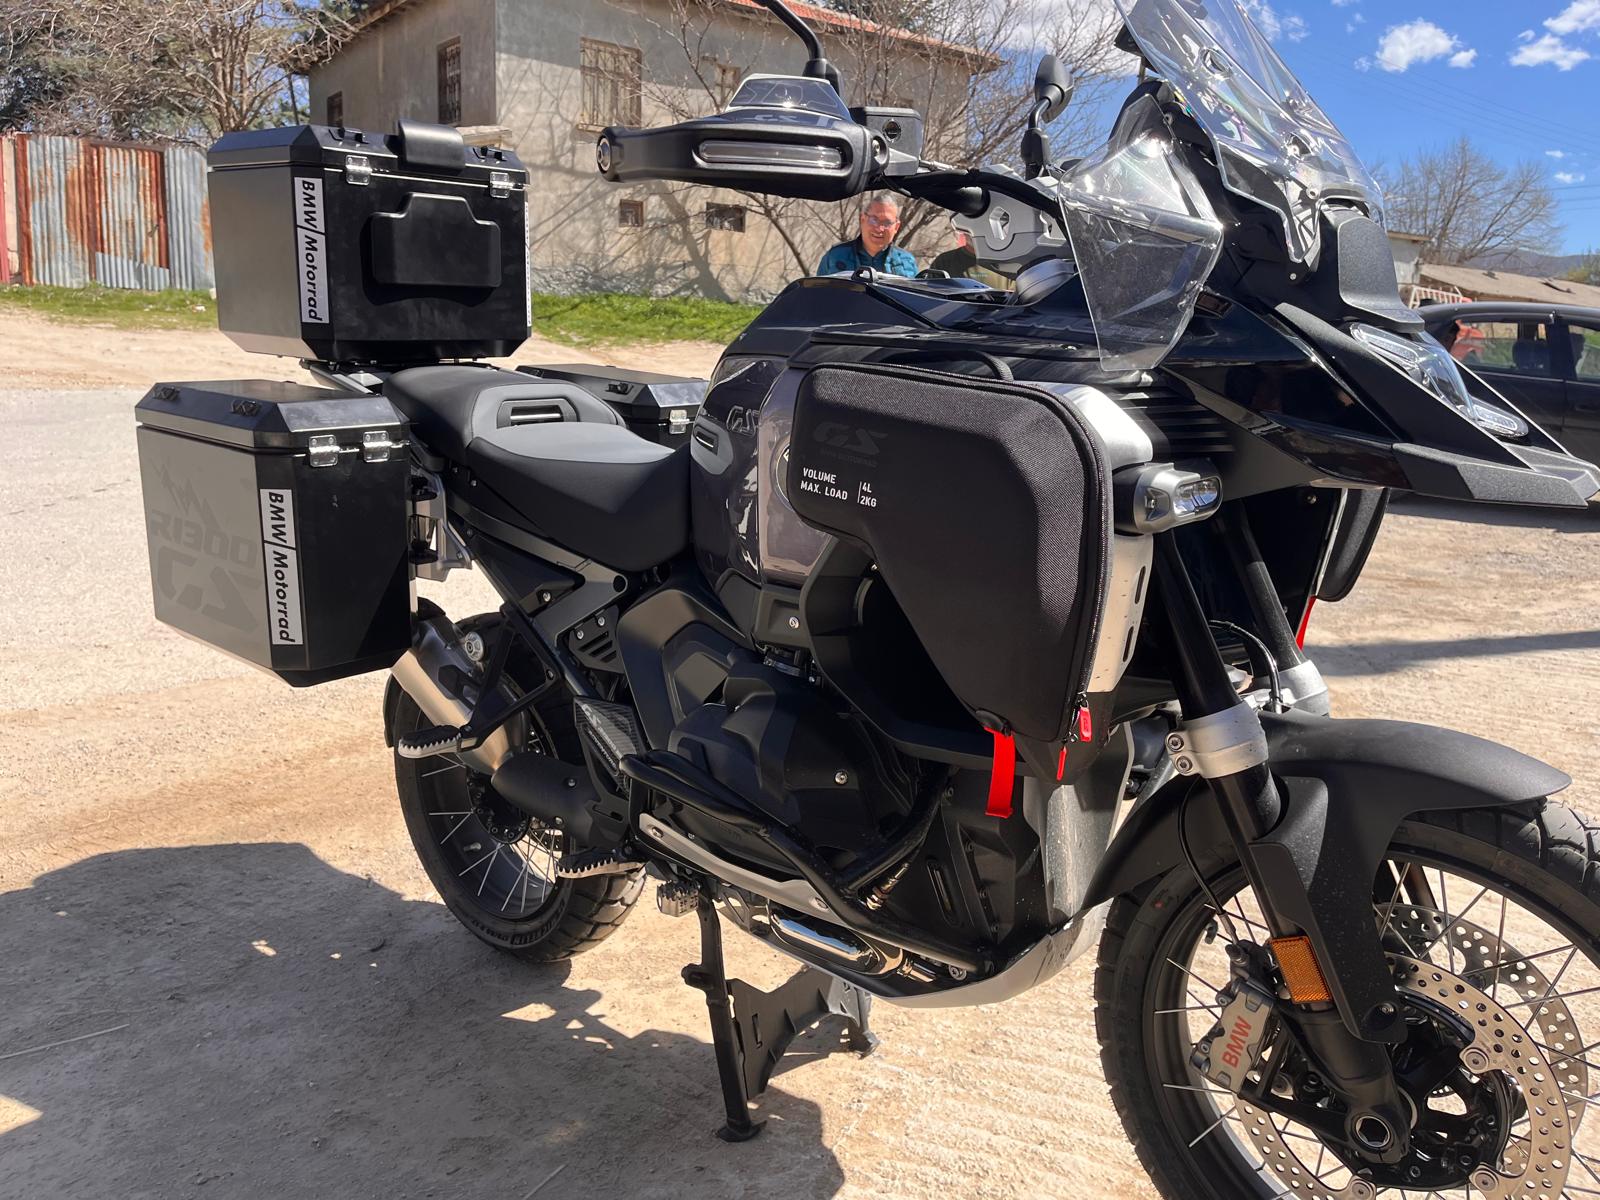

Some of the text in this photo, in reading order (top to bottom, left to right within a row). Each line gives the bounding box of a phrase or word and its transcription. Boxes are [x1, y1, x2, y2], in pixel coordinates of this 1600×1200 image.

[301, 179, 323, 321] BMW Motorrad
[801, 480, 877, 508] MAX. LOAD 2KG
[803, 466, 873, 494] VOLUME 4L
[149, 509, 257, 568] R1300
[268, 491, 296, 643] BMW Motorrad
[157, 546, 263, 631] GS
[1222, 1016, 1252, 1068] BMW
